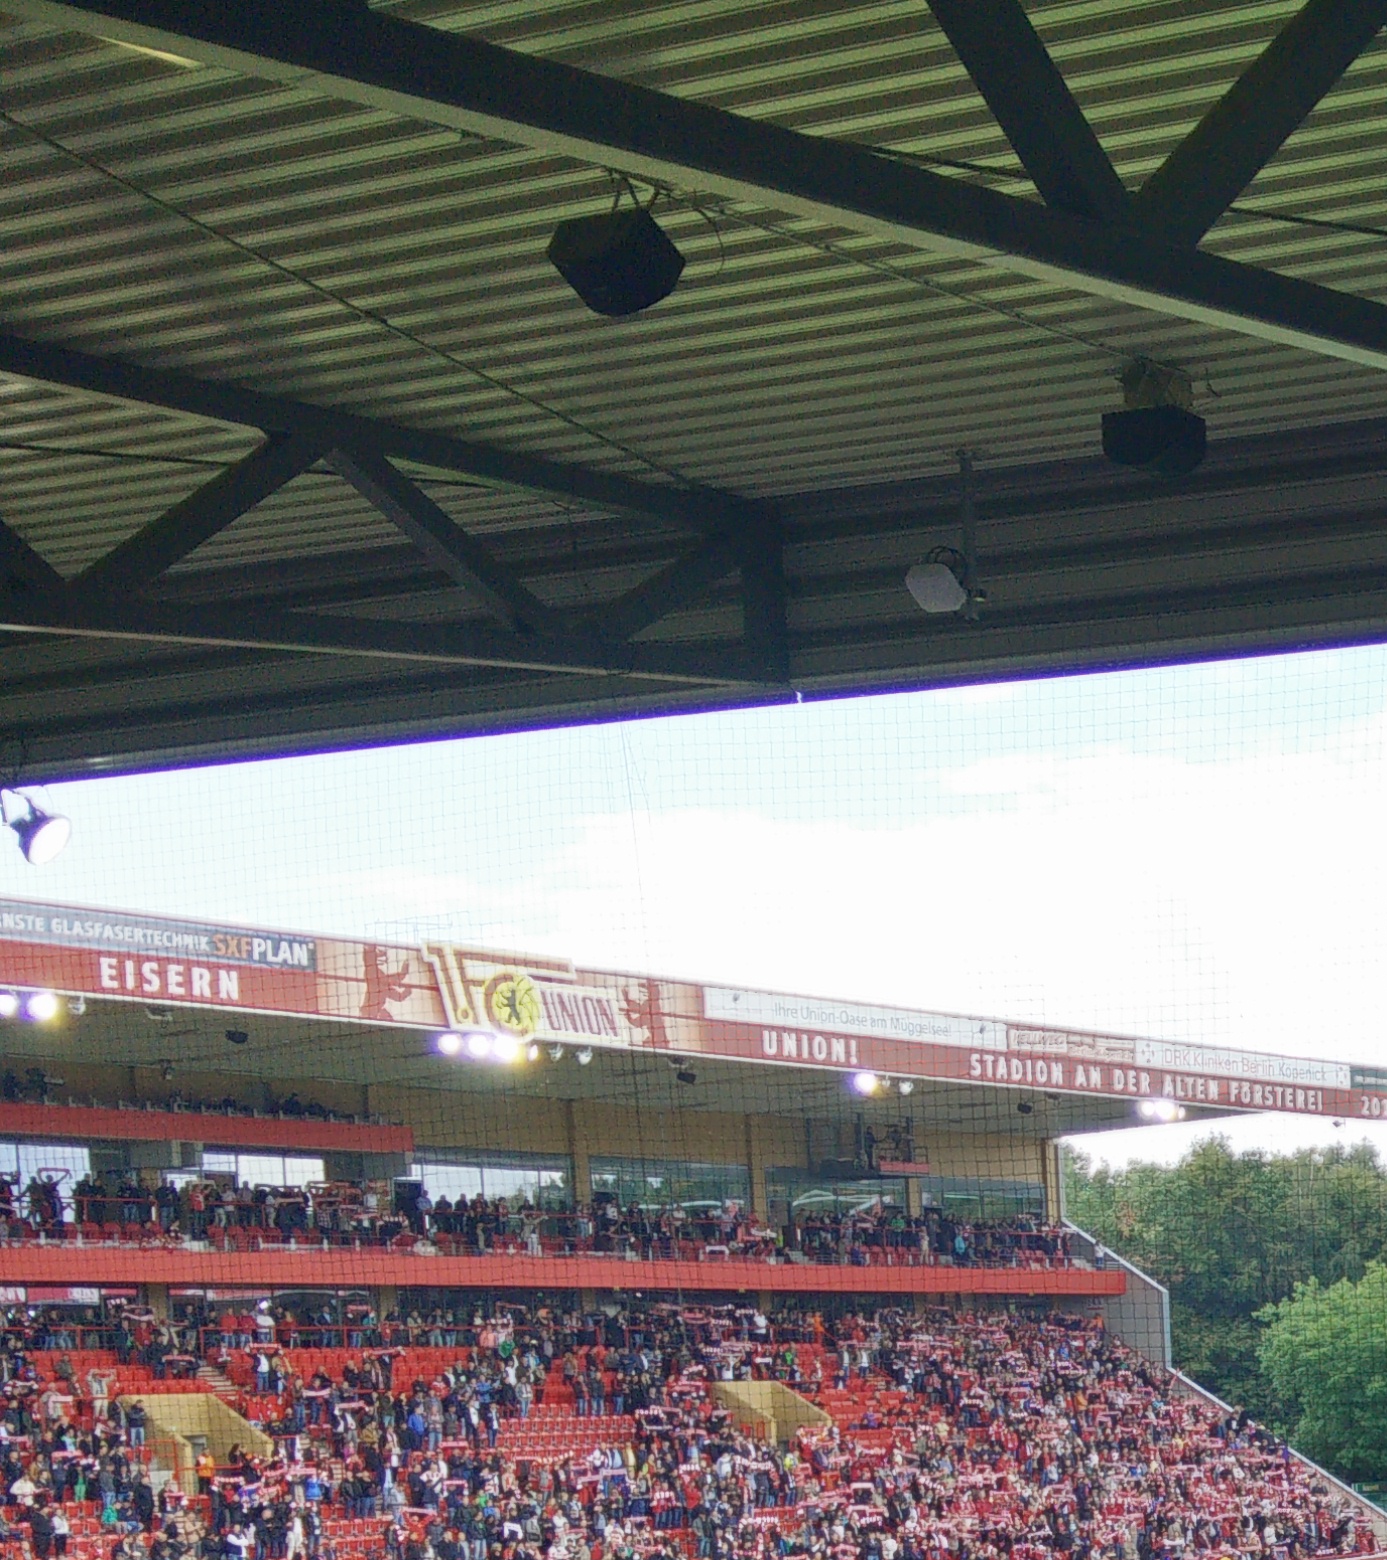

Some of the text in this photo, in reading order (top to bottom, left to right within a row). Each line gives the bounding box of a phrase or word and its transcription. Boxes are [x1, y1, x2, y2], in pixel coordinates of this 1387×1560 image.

[52, 918, 210, 951] GLASFASERTECHNIK
[100, 957, 240, 1000] EISERN
[541, 989, 618, 1037] UNION
[774, 1002, 798, 1019] Ihre
[870, 1017, 887, 1029] am
[763, 1029, 858, 1064] UNION!
[1164, 1048, 1191, 1066] DRK
[1193, 1050, 1239, 1071] Kliniken
[1242, 1056, 1275, 1076] Berlin
[969, 1053, 1063, 1086] STADION
[1075, 1065, 1100, 1088] AN
[1113, 1069, 1150, 1093] DER
[1162, 1075, 1219, 1100] ALTEN
[1229, 1081, 1323, 1112] FÖRSTEREI
